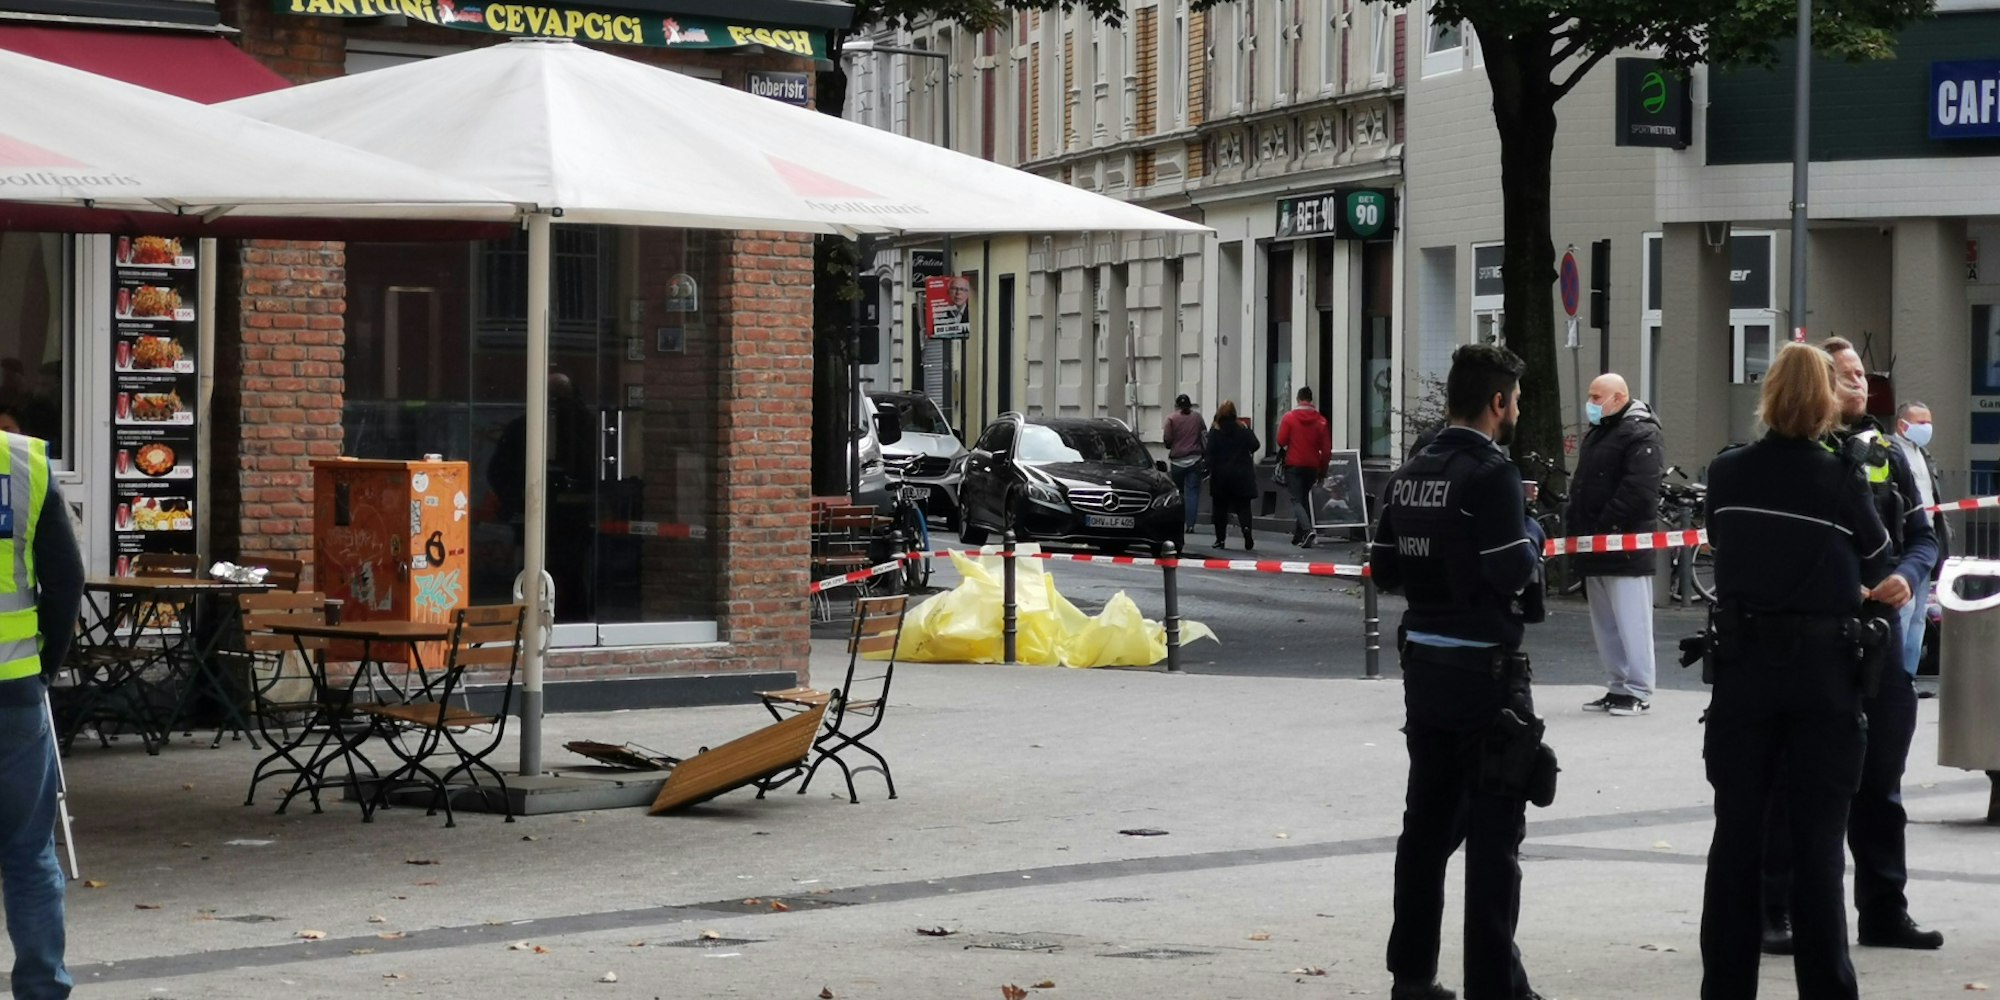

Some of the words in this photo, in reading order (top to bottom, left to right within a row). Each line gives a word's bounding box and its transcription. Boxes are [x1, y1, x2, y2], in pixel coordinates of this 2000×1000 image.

[485, 3, 644, 44] CEVAPCiCi
[727, 25, 814, 56] FiSCH
[1631, 125, 1677, 135] SPORTWETTEN
[0, 172, 142, 186] ollinaris
[804, 199, 930, 215] Apollinaris
[1358, 195, 1375, 204] BET
[1296, 199, 1320, 232] BET
[1321, 196, 1335, 231] 90
[1355, 204, 1378, 226] 90
[1729, 269, 1752, 281] er
[1392, 479, 1451, 507] POLIZEI
[1110, 518, 1120, 527] LF
[1398, 535, 1430, 557] NRW
